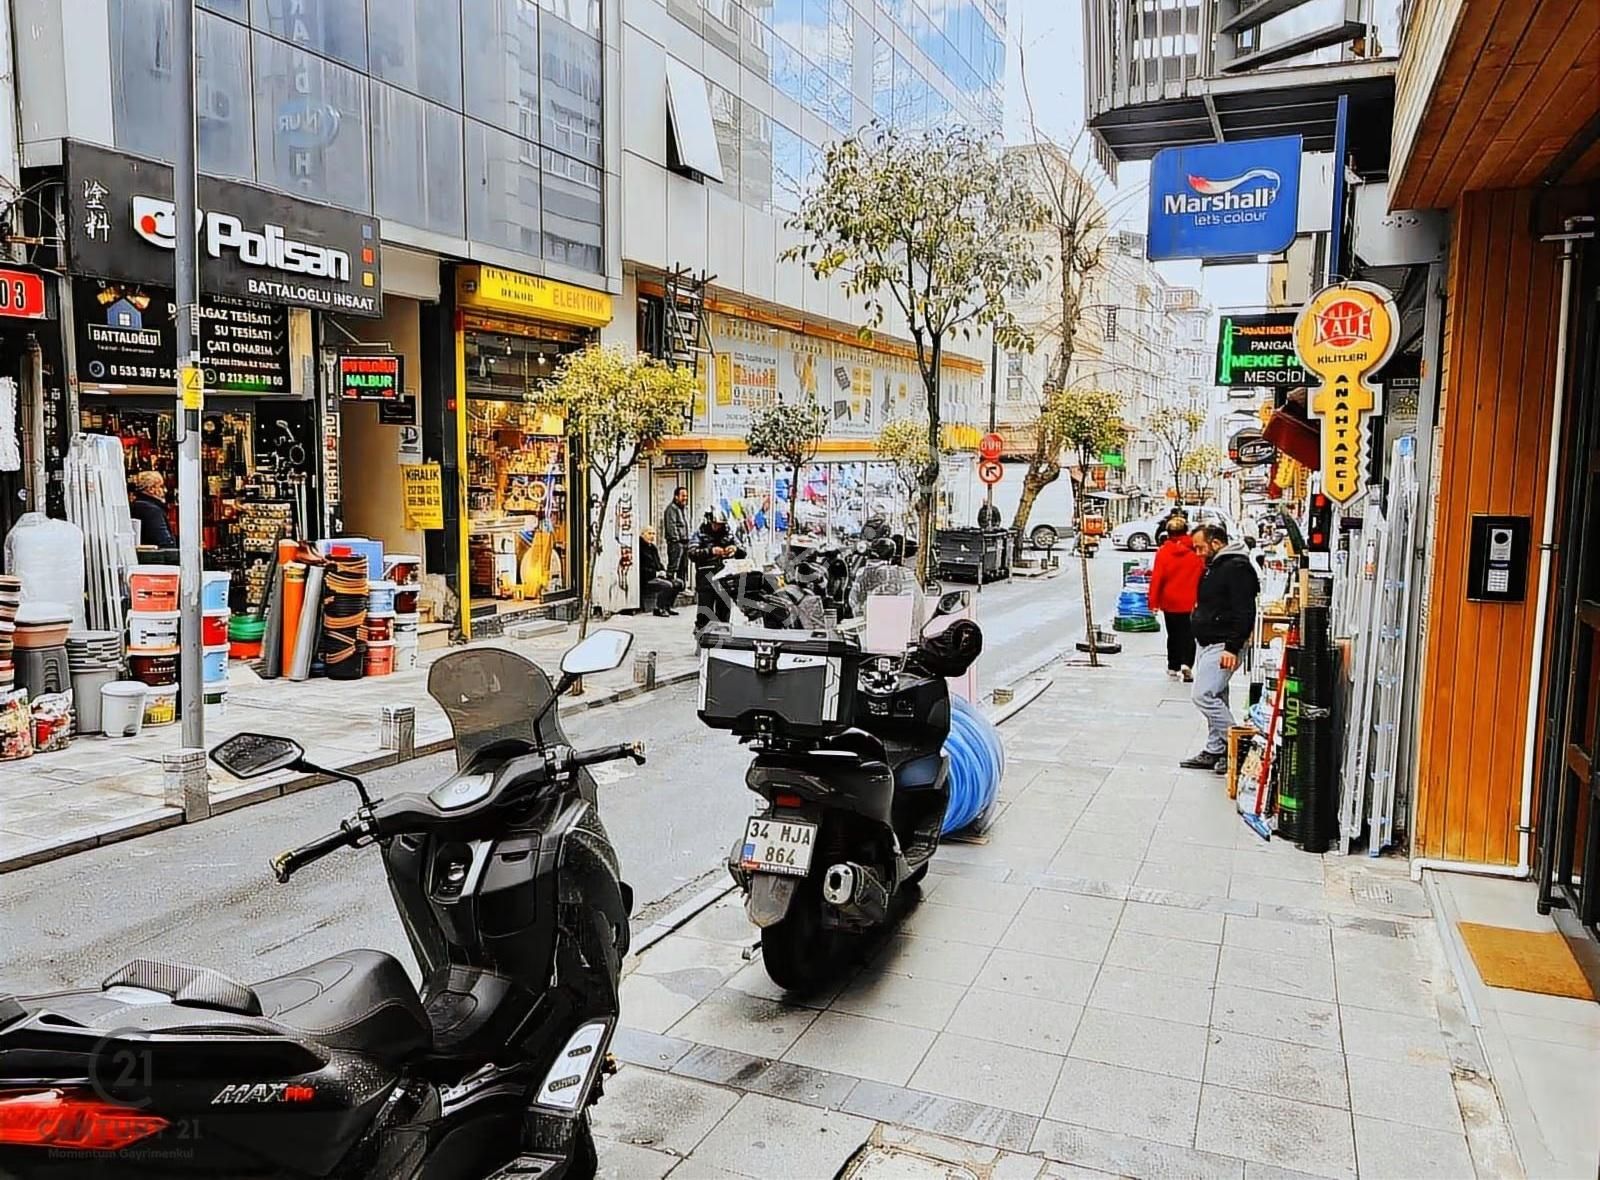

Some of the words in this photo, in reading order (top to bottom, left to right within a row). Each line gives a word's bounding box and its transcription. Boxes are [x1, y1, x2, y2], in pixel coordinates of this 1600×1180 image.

[1164, 187, 1269, 214] Marshall
[1194, 213, 1221, 226] let's
[1223, 210, 1268, 224] colour
[207, 211, 349, 282] Polisan
[248, 279, 331, 304] BATTALOGLU
[214, 324, 229, 336] SU
[1314, 310, 1373, 347] KALE
[93, 329, 158, 346] BATTALOĞLU
[1250, 340, 1295, 351] PANGAL
[206, 340, 231, 354] ÇATI
[232, 342, 273, 356] ONARIM
[1232, 354, 1284, 368] MEKKE
[1286, 354, 1300, 367] N
[110, 364, 118, 376] 0
[119, 365, 138, 377] 533
[1244, 369, 1306, 383] MESCİDİ
[346, 374, 393, 387] NALBUR
[750, 822, 770, 840] 34
[780, 825, 811, 846] HJA
[765, 846, 796, 866] 864
[210, 1082, 289, 1105] MAX
